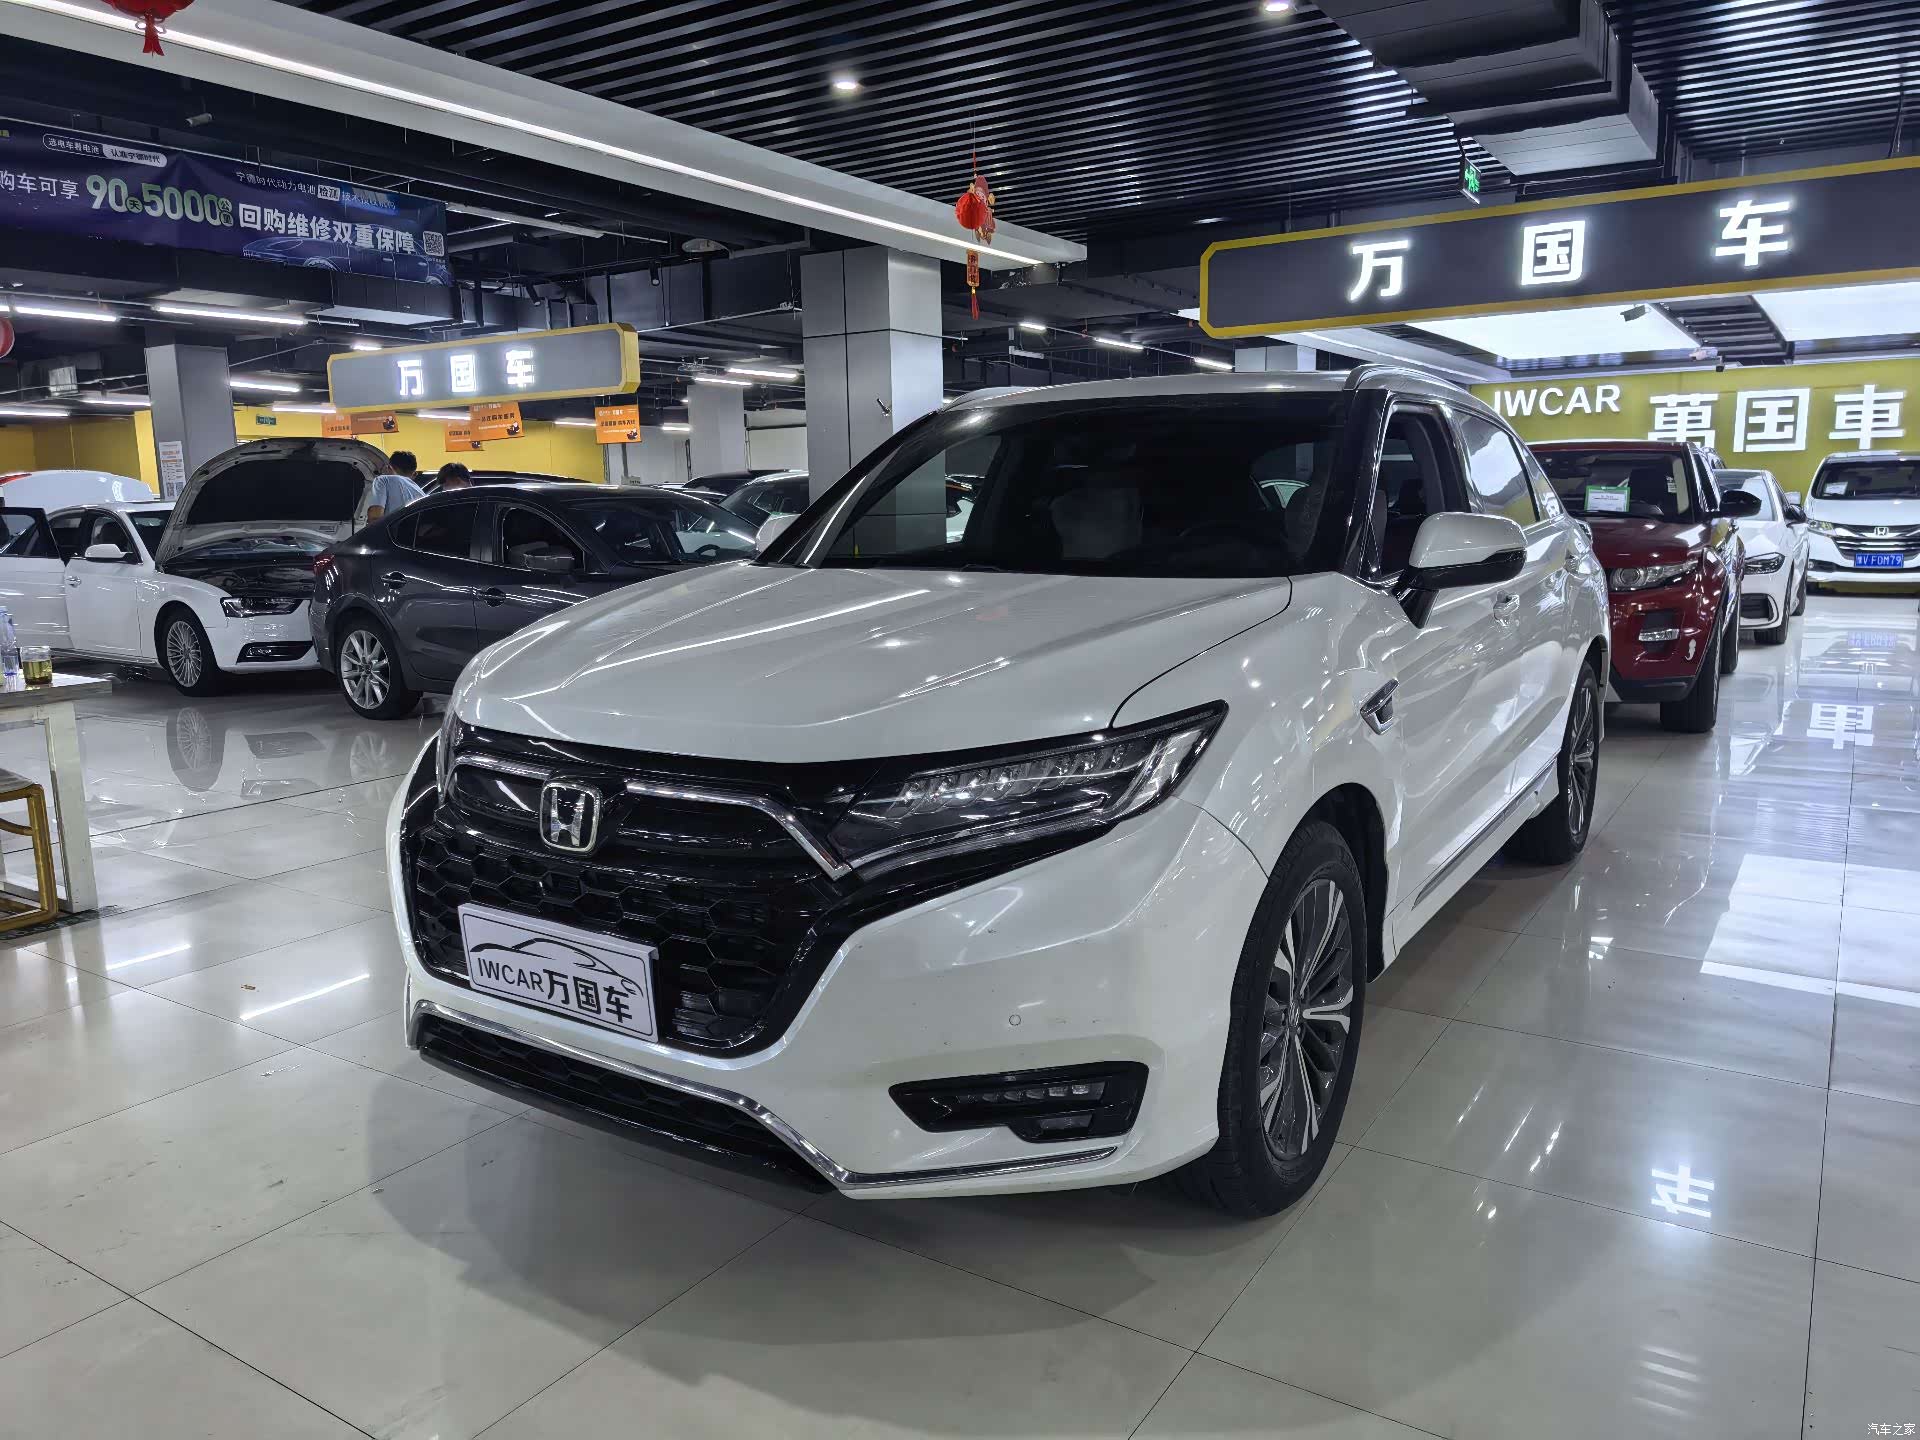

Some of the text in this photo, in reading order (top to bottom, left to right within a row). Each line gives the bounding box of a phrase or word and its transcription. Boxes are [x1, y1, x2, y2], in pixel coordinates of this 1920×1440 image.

[238, 202, 416, 255] 回购维修双重保障
[1349, 199, 1791, 301] 万国车
[397, 349, 535, 396] 万国车
[1493, 384, 1622, 418] IWCAR
[477, 957, 633, 1024] IWCAR万国车
